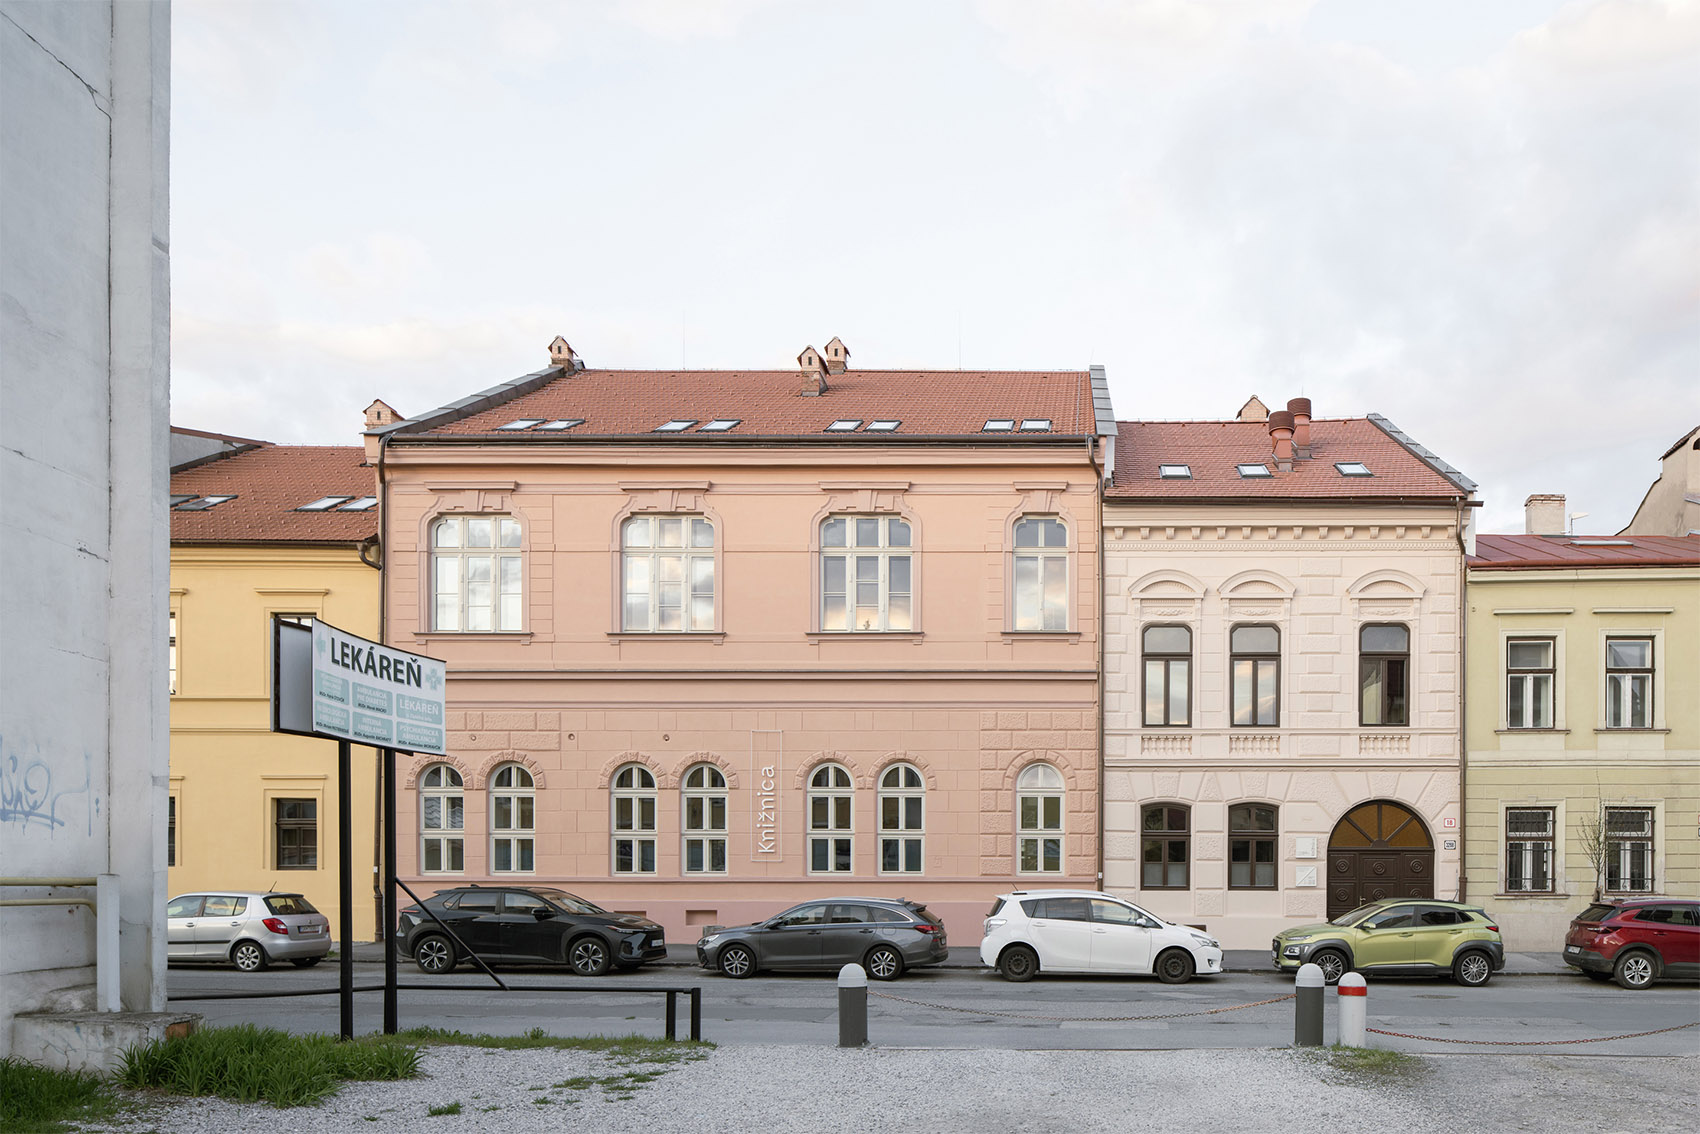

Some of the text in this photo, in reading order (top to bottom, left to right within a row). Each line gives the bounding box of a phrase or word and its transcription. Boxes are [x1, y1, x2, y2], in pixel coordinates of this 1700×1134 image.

[331, 637, 422, 688] LEKÁREŇ
[399, 698, 438, 715] LEKÁREŇ
[757, 765, 776, 853] Knižnica
